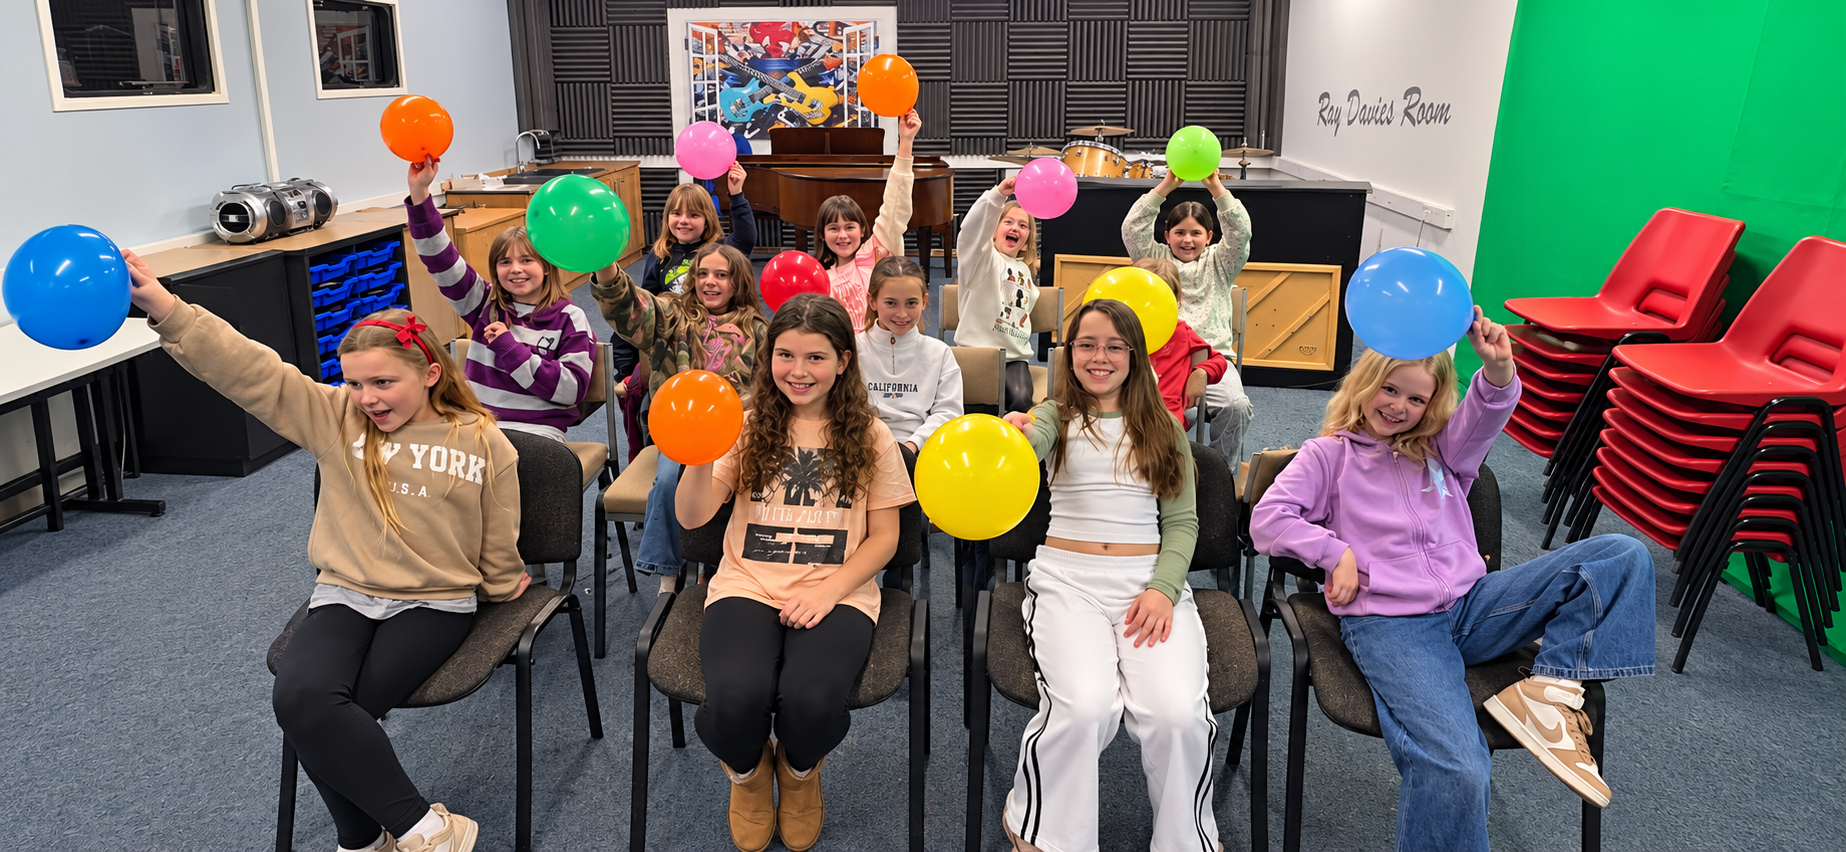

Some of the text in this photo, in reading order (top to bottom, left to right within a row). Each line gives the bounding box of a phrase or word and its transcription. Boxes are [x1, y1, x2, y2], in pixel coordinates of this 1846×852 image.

[1317, 86, 1451, 137] Ray Davies Room
[867, 382, 918, 392] CALIFORNIA
[409, 443, 486, 485] YORK
